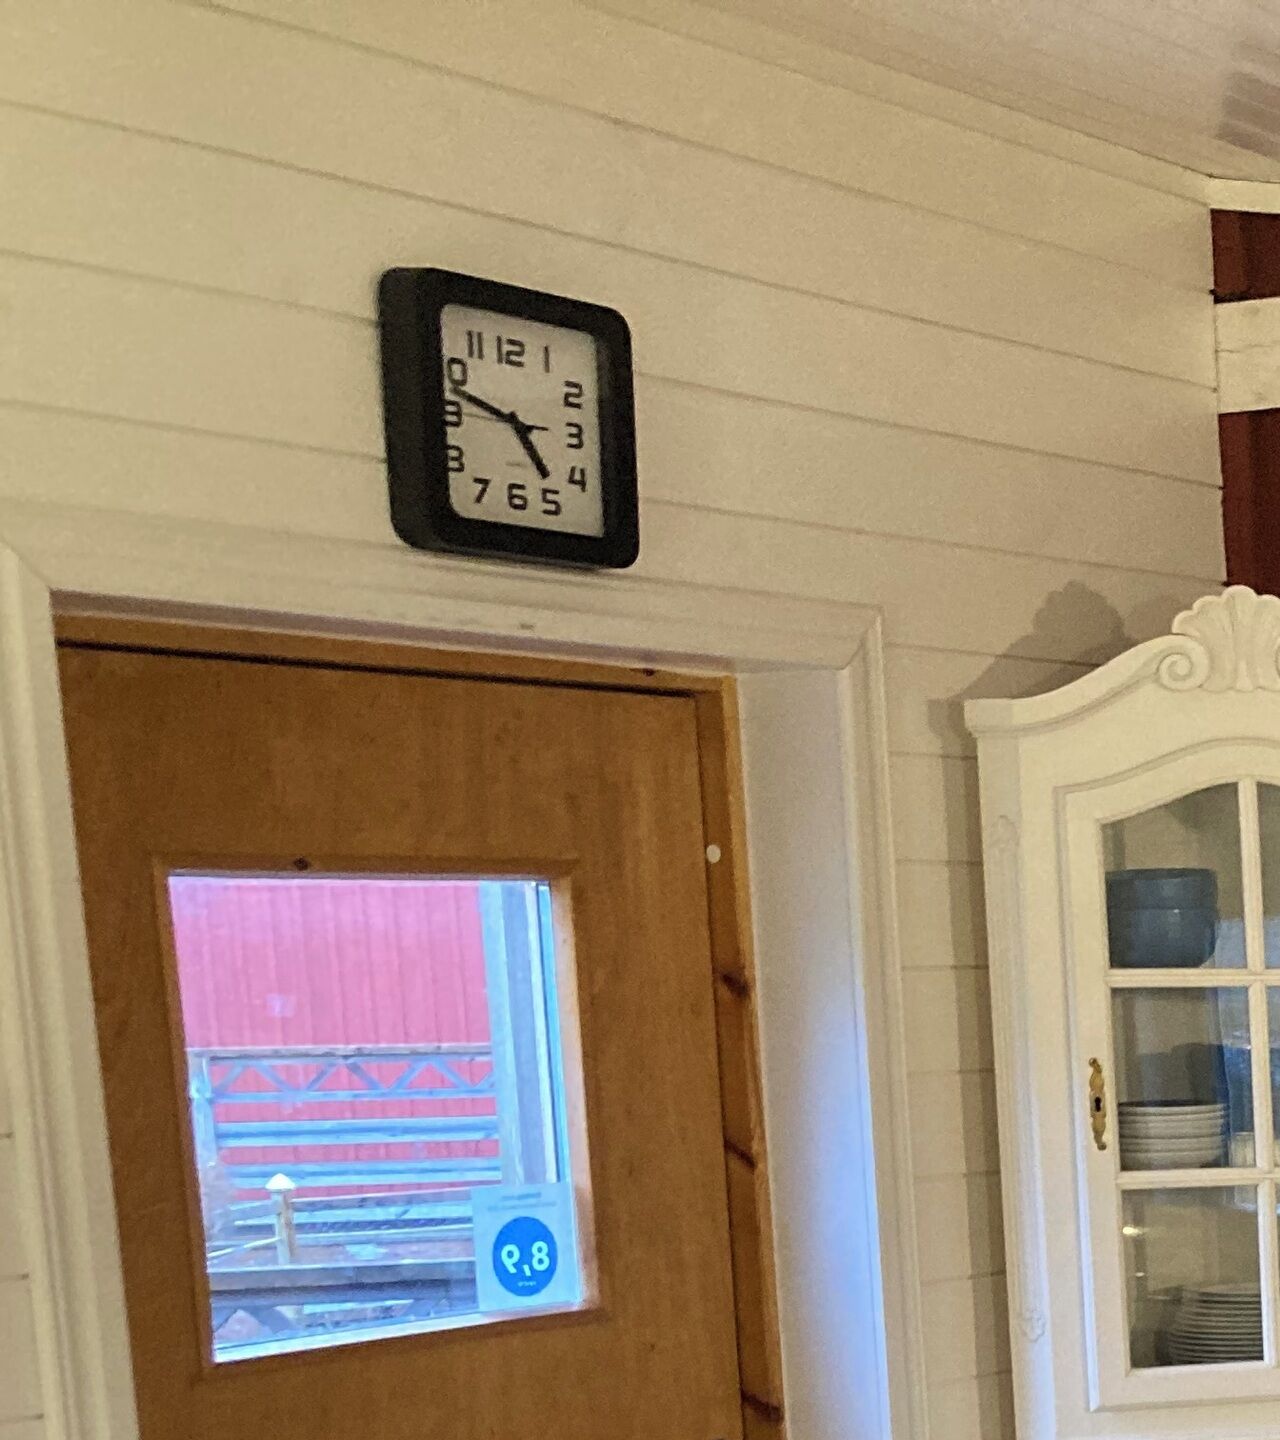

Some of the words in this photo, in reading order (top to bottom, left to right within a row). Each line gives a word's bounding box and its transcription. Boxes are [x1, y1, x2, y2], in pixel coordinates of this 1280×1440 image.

[466, 331, 484, 360] 11
[496, 335, 526, 368] 12
[545, 346, 550, 373] 1
[564, 381, 583, 408] 2
[566, 423, 583, 449] 3
[473, 478, 491, 504] 7
[568, 467, 586, 493] 4
[507, 483, 527, 510] 6
[541, 489, 561, 515] 5
